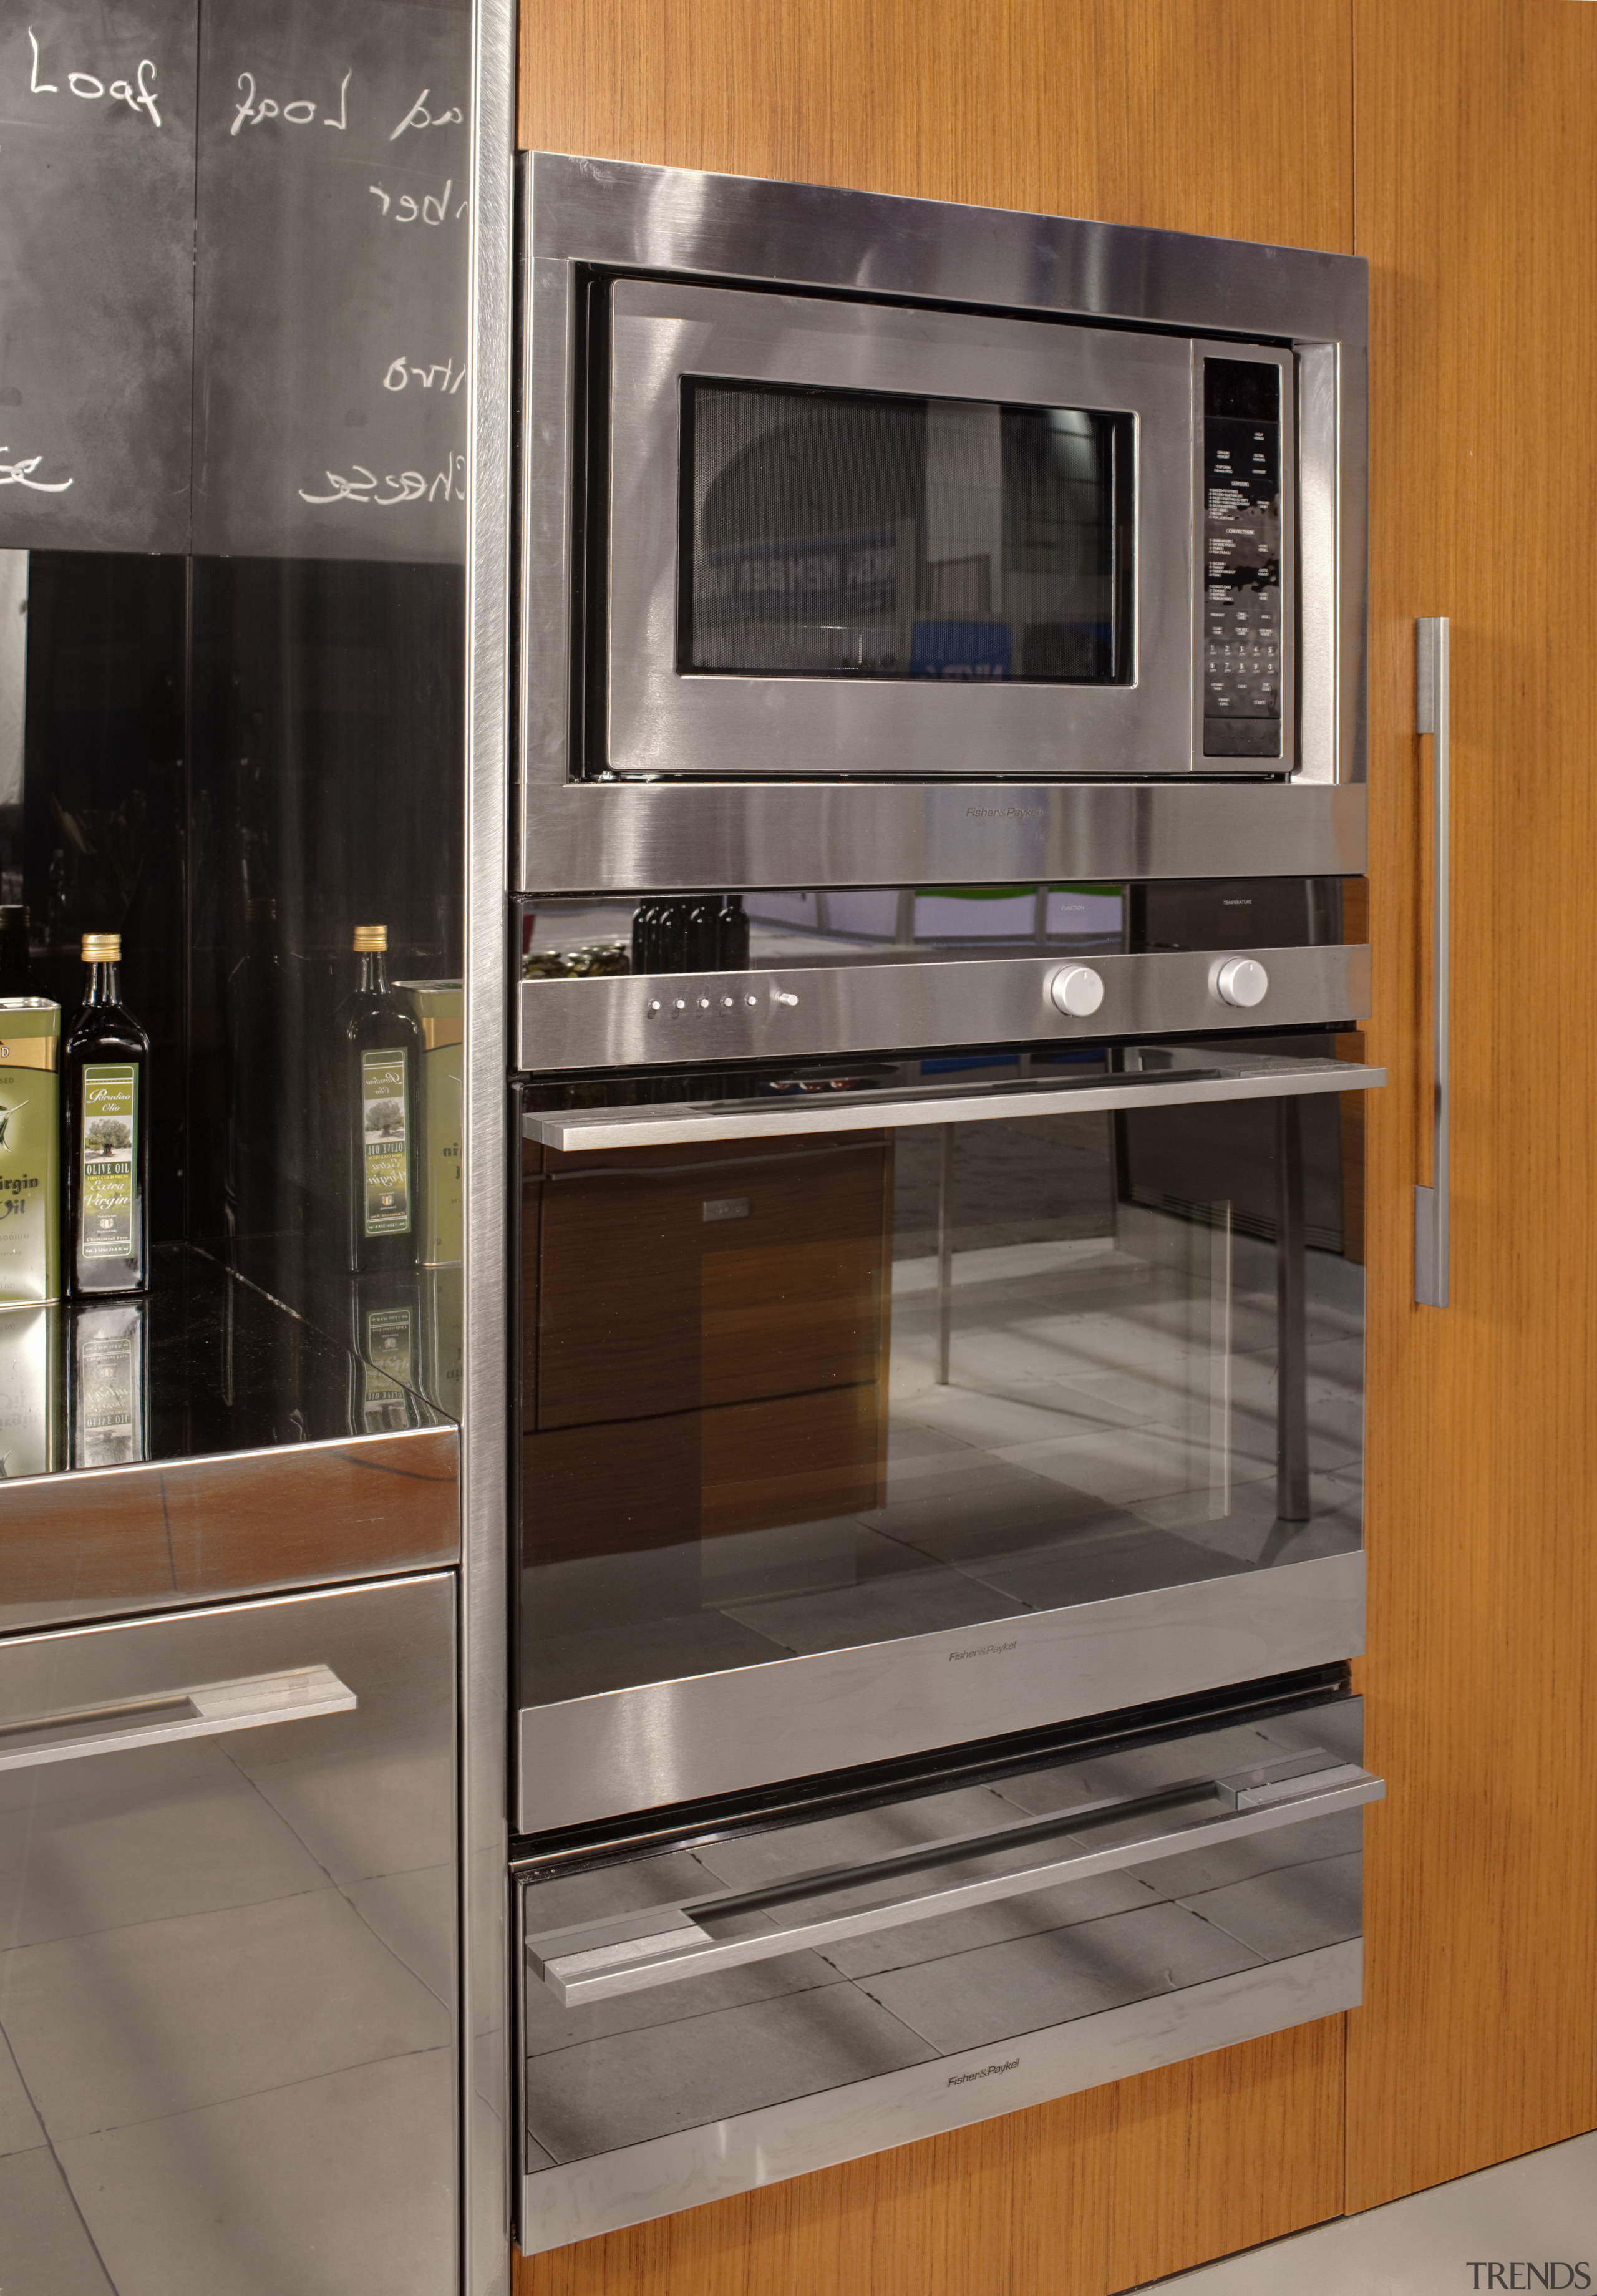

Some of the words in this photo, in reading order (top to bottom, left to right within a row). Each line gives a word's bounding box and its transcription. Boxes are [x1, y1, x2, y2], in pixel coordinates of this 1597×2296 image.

[28, 24, 162, 127] Loaf
[86, 1088, 130, 1103] Paradiso
[102, 1102, 120, 1112] Olio
[87, 1164, 112, 1175] OLIVE
[115, 1162, 129, 1174] OIL
[90, 1180, 125, 1191] Extra
[84, 1193, 130, 1210] Virgin
[949, 1640, 1017, 1661] Fisher&Paykel
[948, 2058, 1019, 2087] Fisher&Paykel
